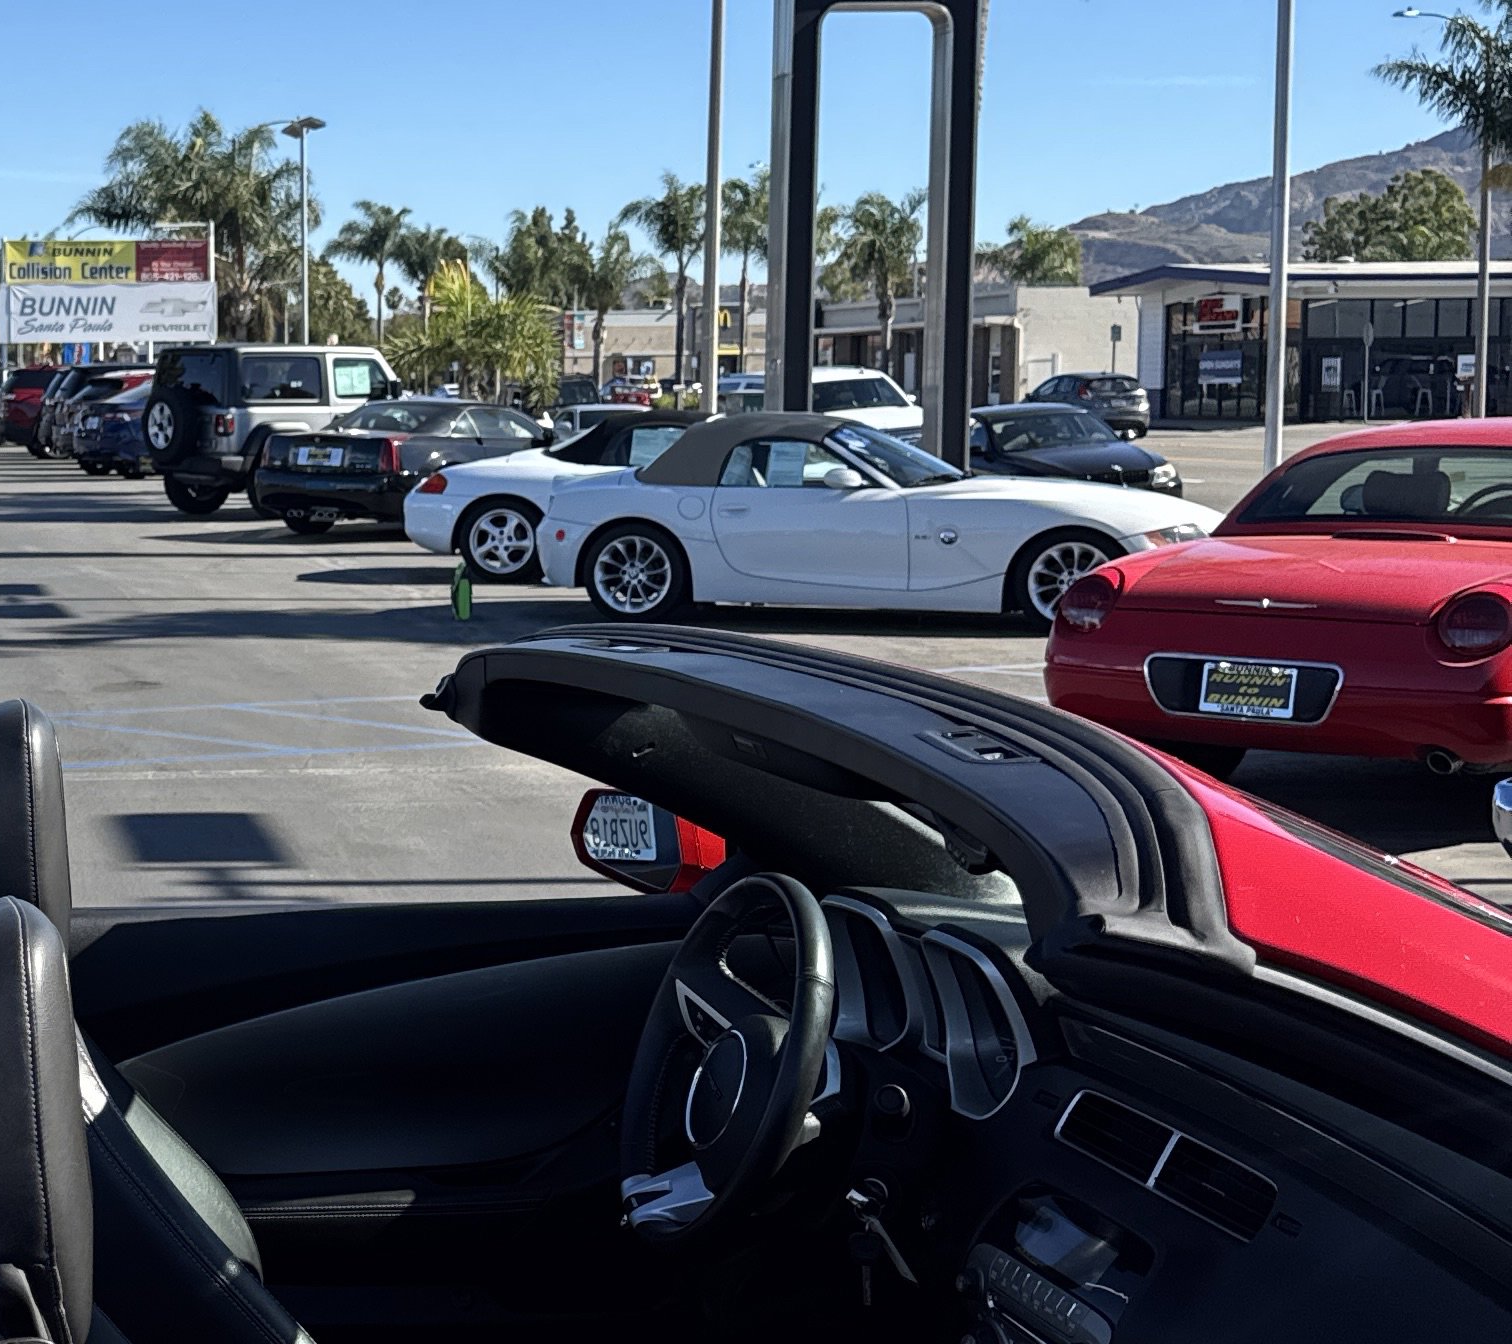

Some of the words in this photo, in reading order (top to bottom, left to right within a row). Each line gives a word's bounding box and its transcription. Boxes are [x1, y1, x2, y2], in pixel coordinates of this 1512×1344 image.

[52, 247, 114, 257] BUNNIN
[9, 262, 72, 280] Collision
[81, 262, 132, 280] Center
[19, 296, 116, 316] BUNNIN
[17, 317, 65, 335] Santa
[69, 317, 113, 333] Paula
[139, 323, 208, 332] CHEVROLET
[1239, 686, 1259, 694] to
[1206, 693, 1285, 707] BUNNIN
